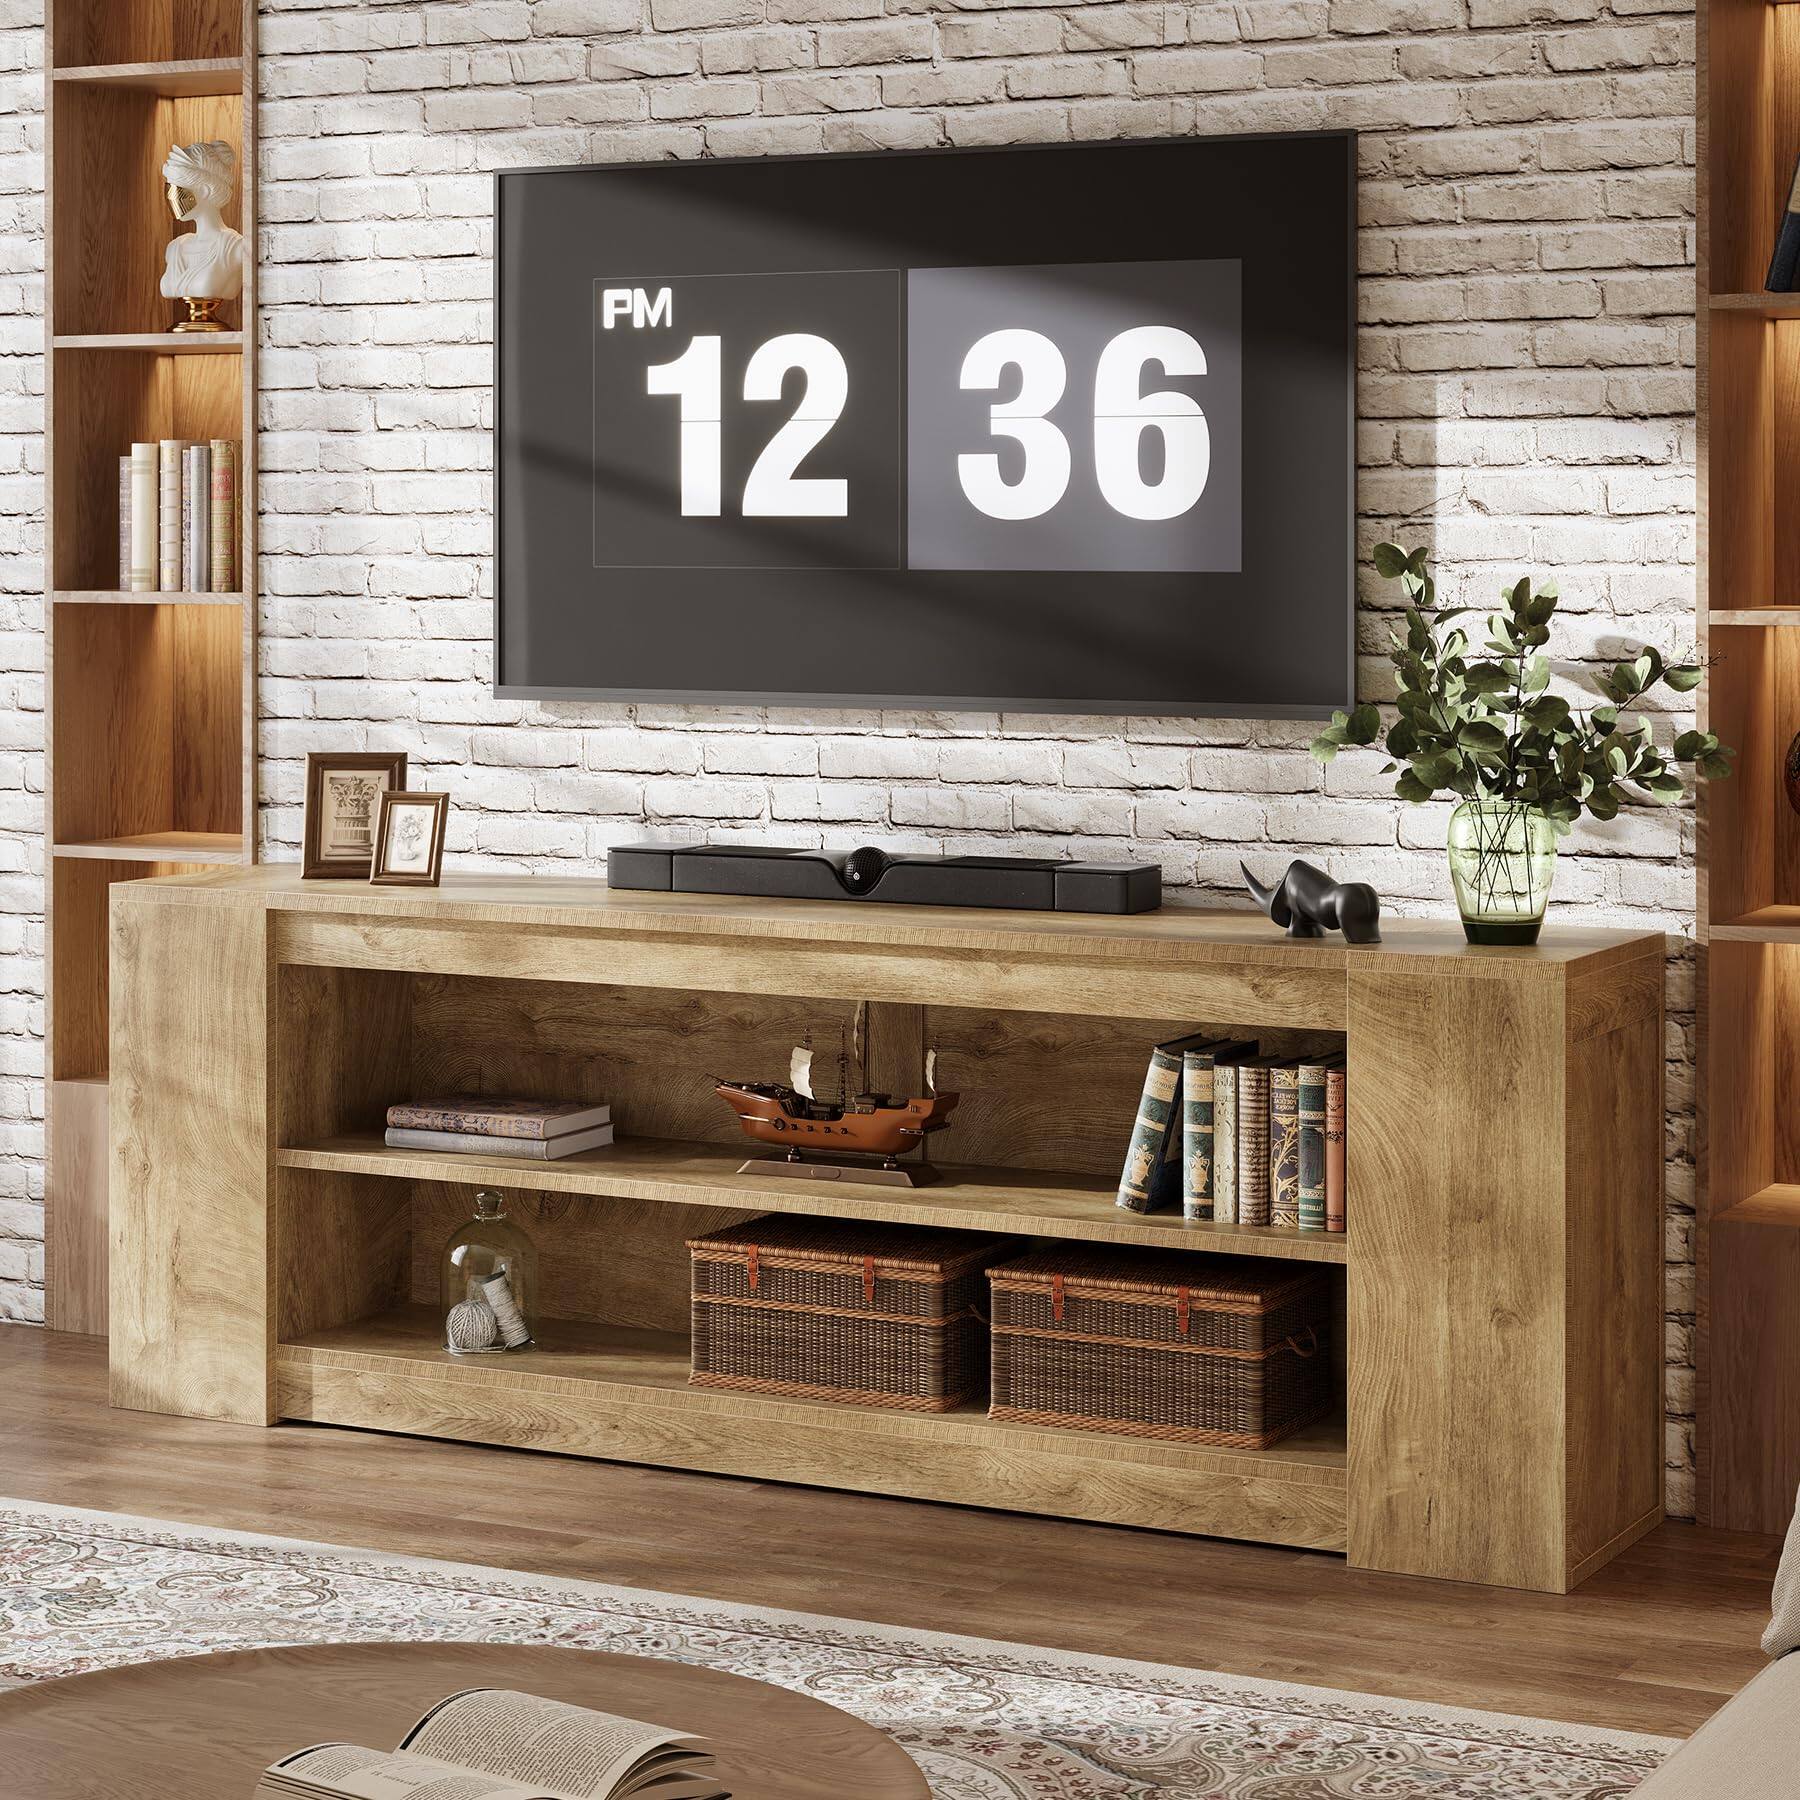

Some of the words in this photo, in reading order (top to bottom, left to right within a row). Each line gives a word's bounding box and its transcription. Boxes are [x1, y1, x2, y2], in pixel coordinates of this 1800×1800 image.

[603, 287, 672, 329] PM
[647, 333, 848, 517] 12
[957, 325, 1211, 520] 36
